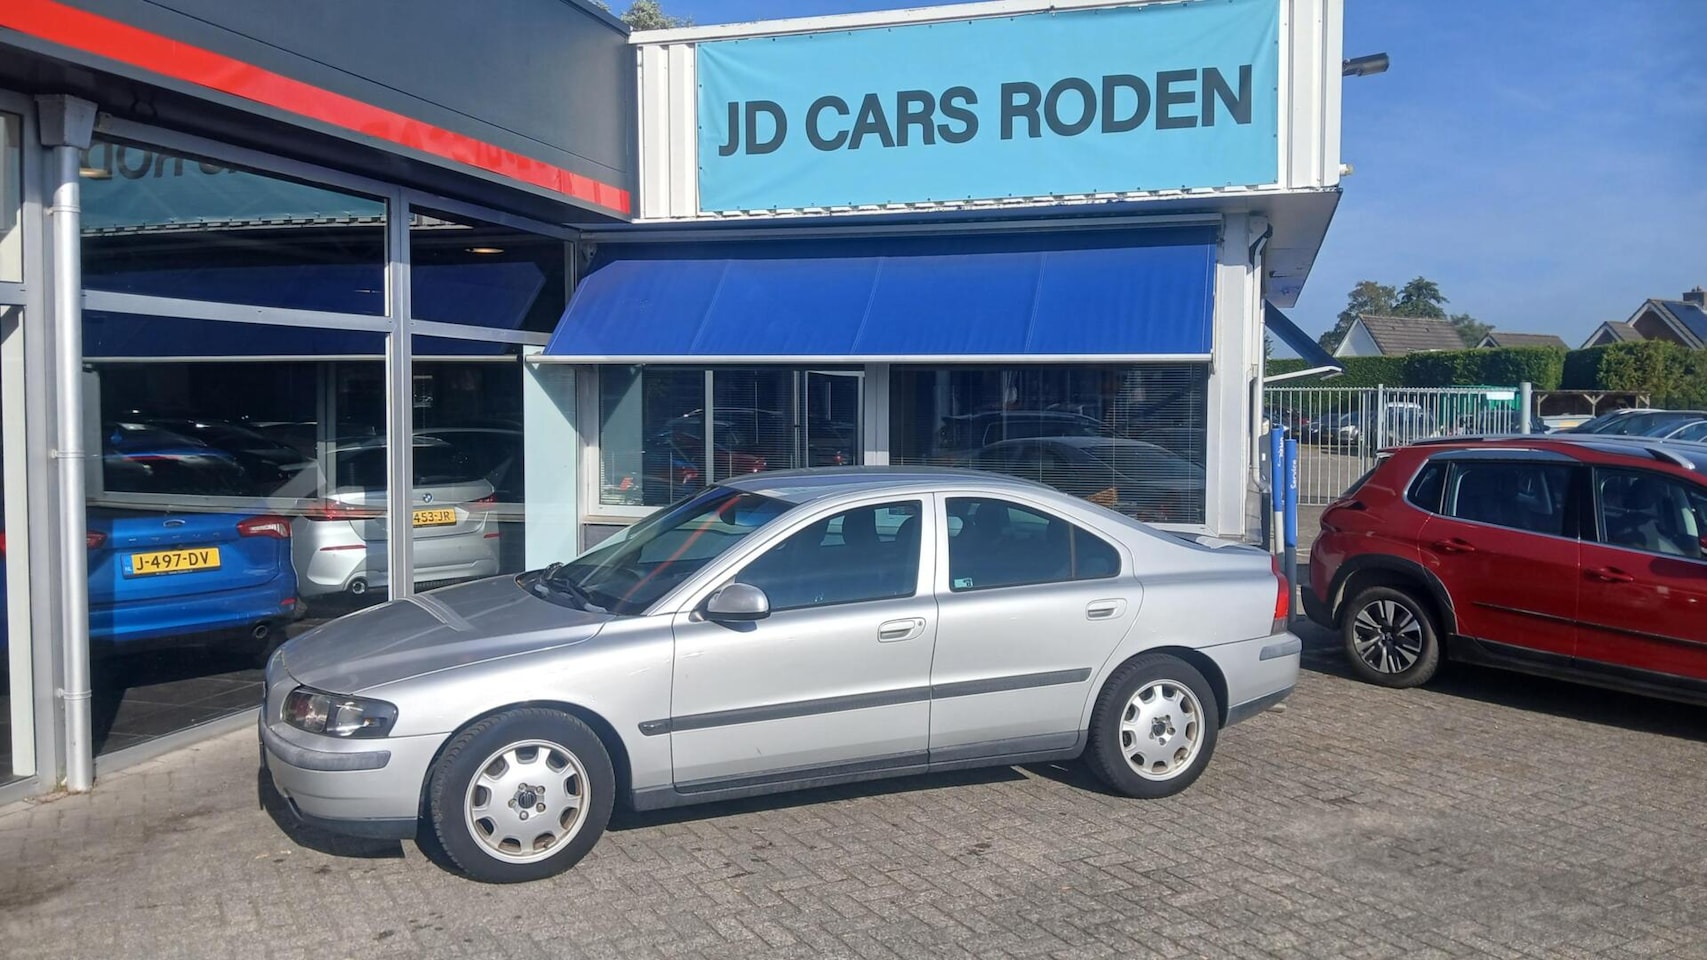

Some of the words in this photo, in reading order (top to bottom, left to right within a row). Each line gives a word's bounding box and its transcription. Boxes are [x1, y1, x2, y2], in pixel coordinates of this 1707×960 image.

[718, 100, 788, 156] JD
[805, 86, 979, 151] CARS
[1000, 64, 1252, 140] RODEN
[413, 511, 451, 523] 453-JR
[136, 551, 209, 571] J-497-DV
